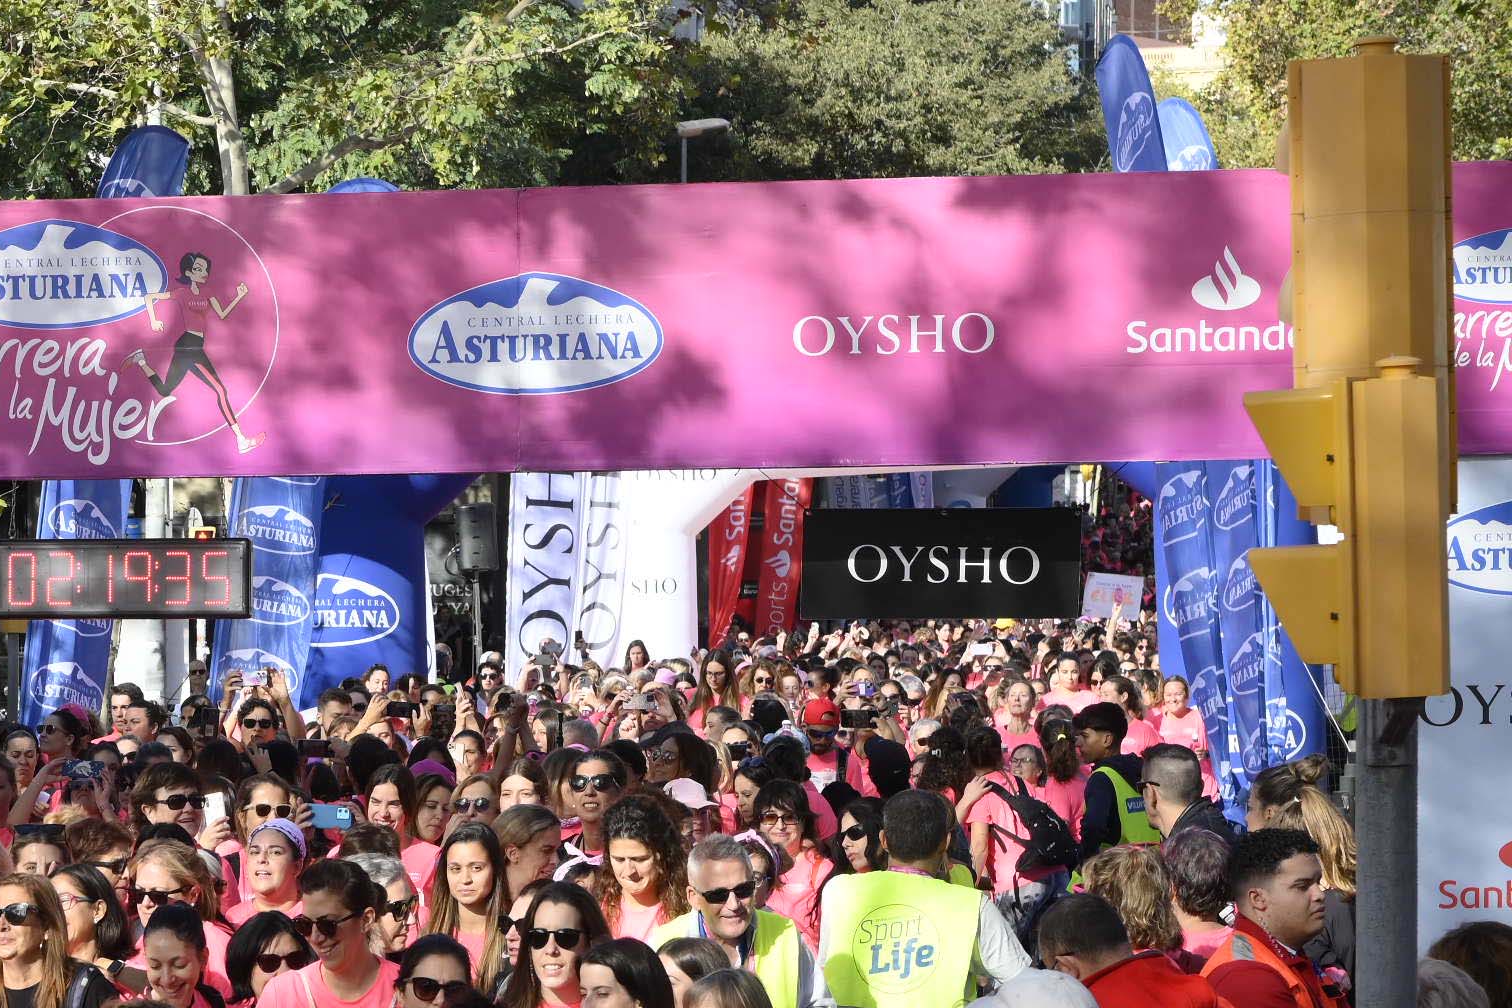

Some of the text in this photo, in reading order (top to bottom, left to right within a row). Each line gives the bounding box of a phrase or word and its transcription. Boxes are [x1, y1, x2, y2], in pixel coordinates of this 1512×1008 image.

[70, 254, 144, 267] LECHERA
[467, 312, 636, 327] CENTRAL LECHERA
[792, 312, 996, 357] OYSHO
[428, 319, 644, 364] ASTURIANA
[1476, 339, 1495, 367] la
[9, 382, 33, 421] la
[28, 371, 177, 466] Mujer
[237, 516, 315, 549] ASTURIANA
[7, 551, 231, 607] 02:19:35
[847, 544, 1041, 585] OYSHO
[337, 598, 385, 607] LECHERA
[35, 675, 97, 713] ASTURIANA
[859, 915, 924, 945] Sport
[869, 937, 935, 980] Life
